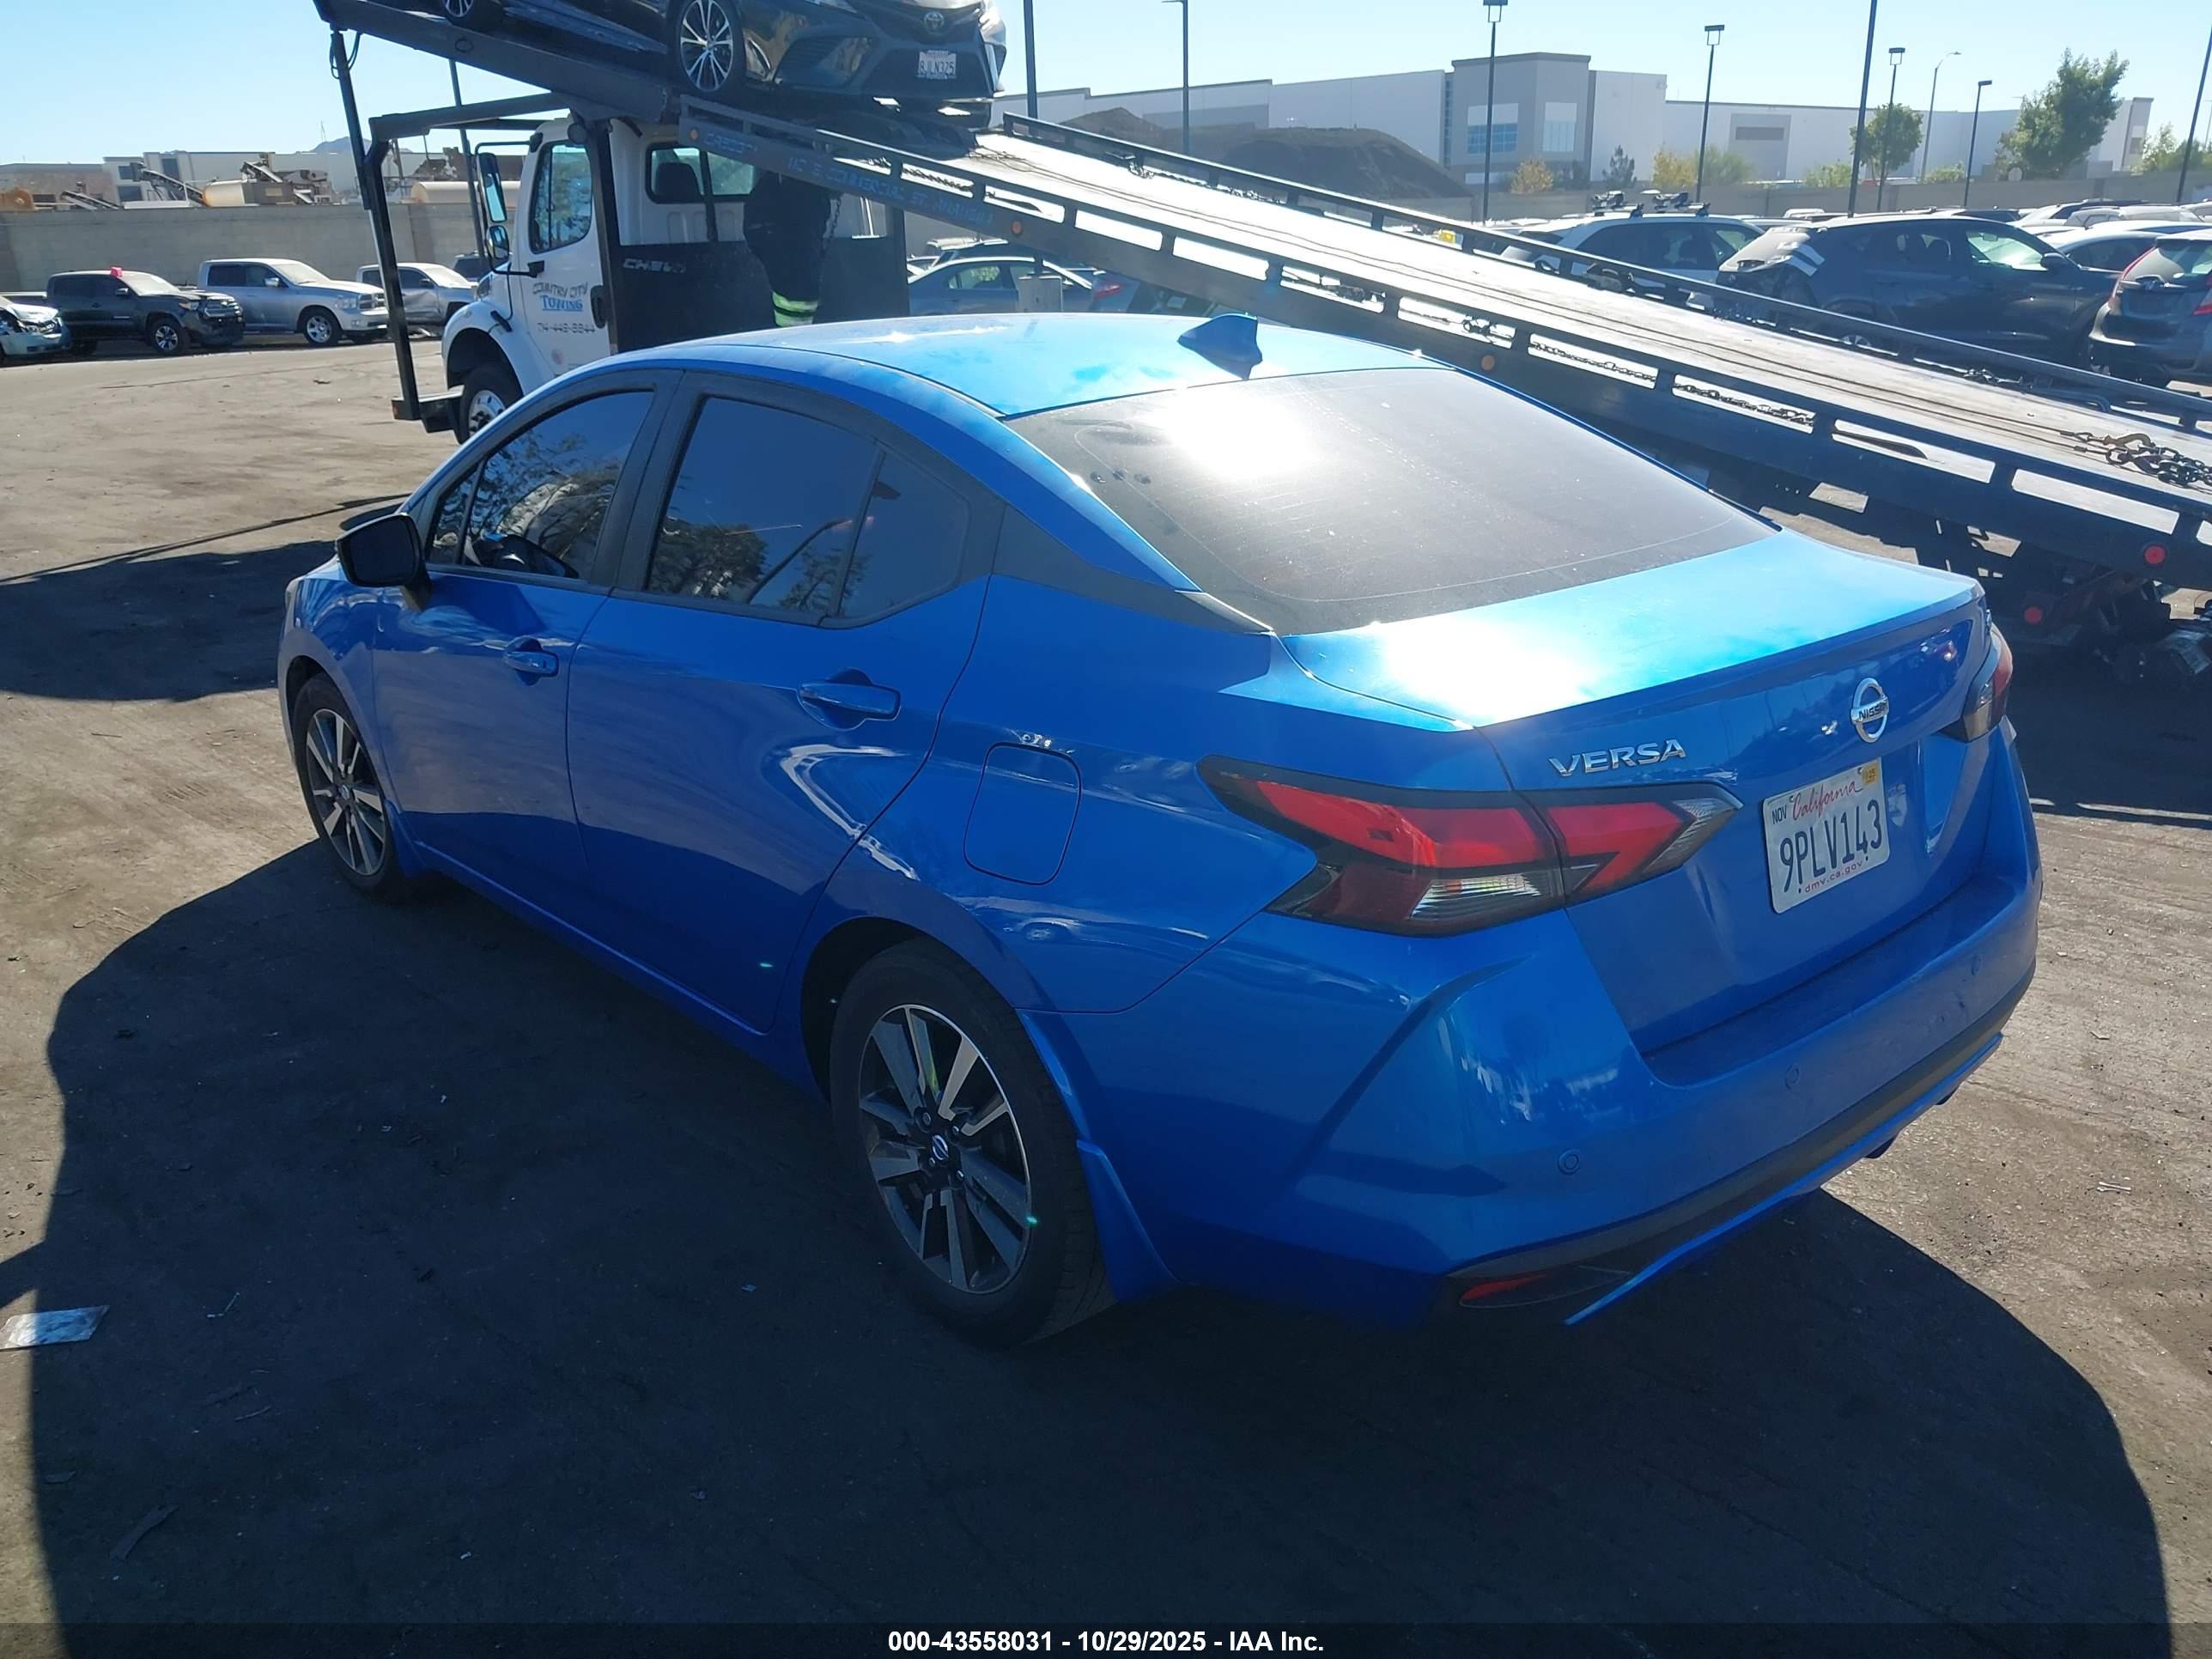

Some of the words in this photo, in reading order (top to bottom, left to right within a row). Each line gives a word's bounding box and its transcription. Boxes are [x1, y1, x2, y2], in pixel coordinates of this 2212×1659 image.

[540, 295, 583, 311] TOWING
[1547, 738, 1688, 777] VERSA
[1771, 804, 1787, 825] NOV
[1791, 780, 1863, 822] California
[1779, 799, 1883, 893] 9PLV143
[1804, 859, 1863, 894] dmv.ca.gov
